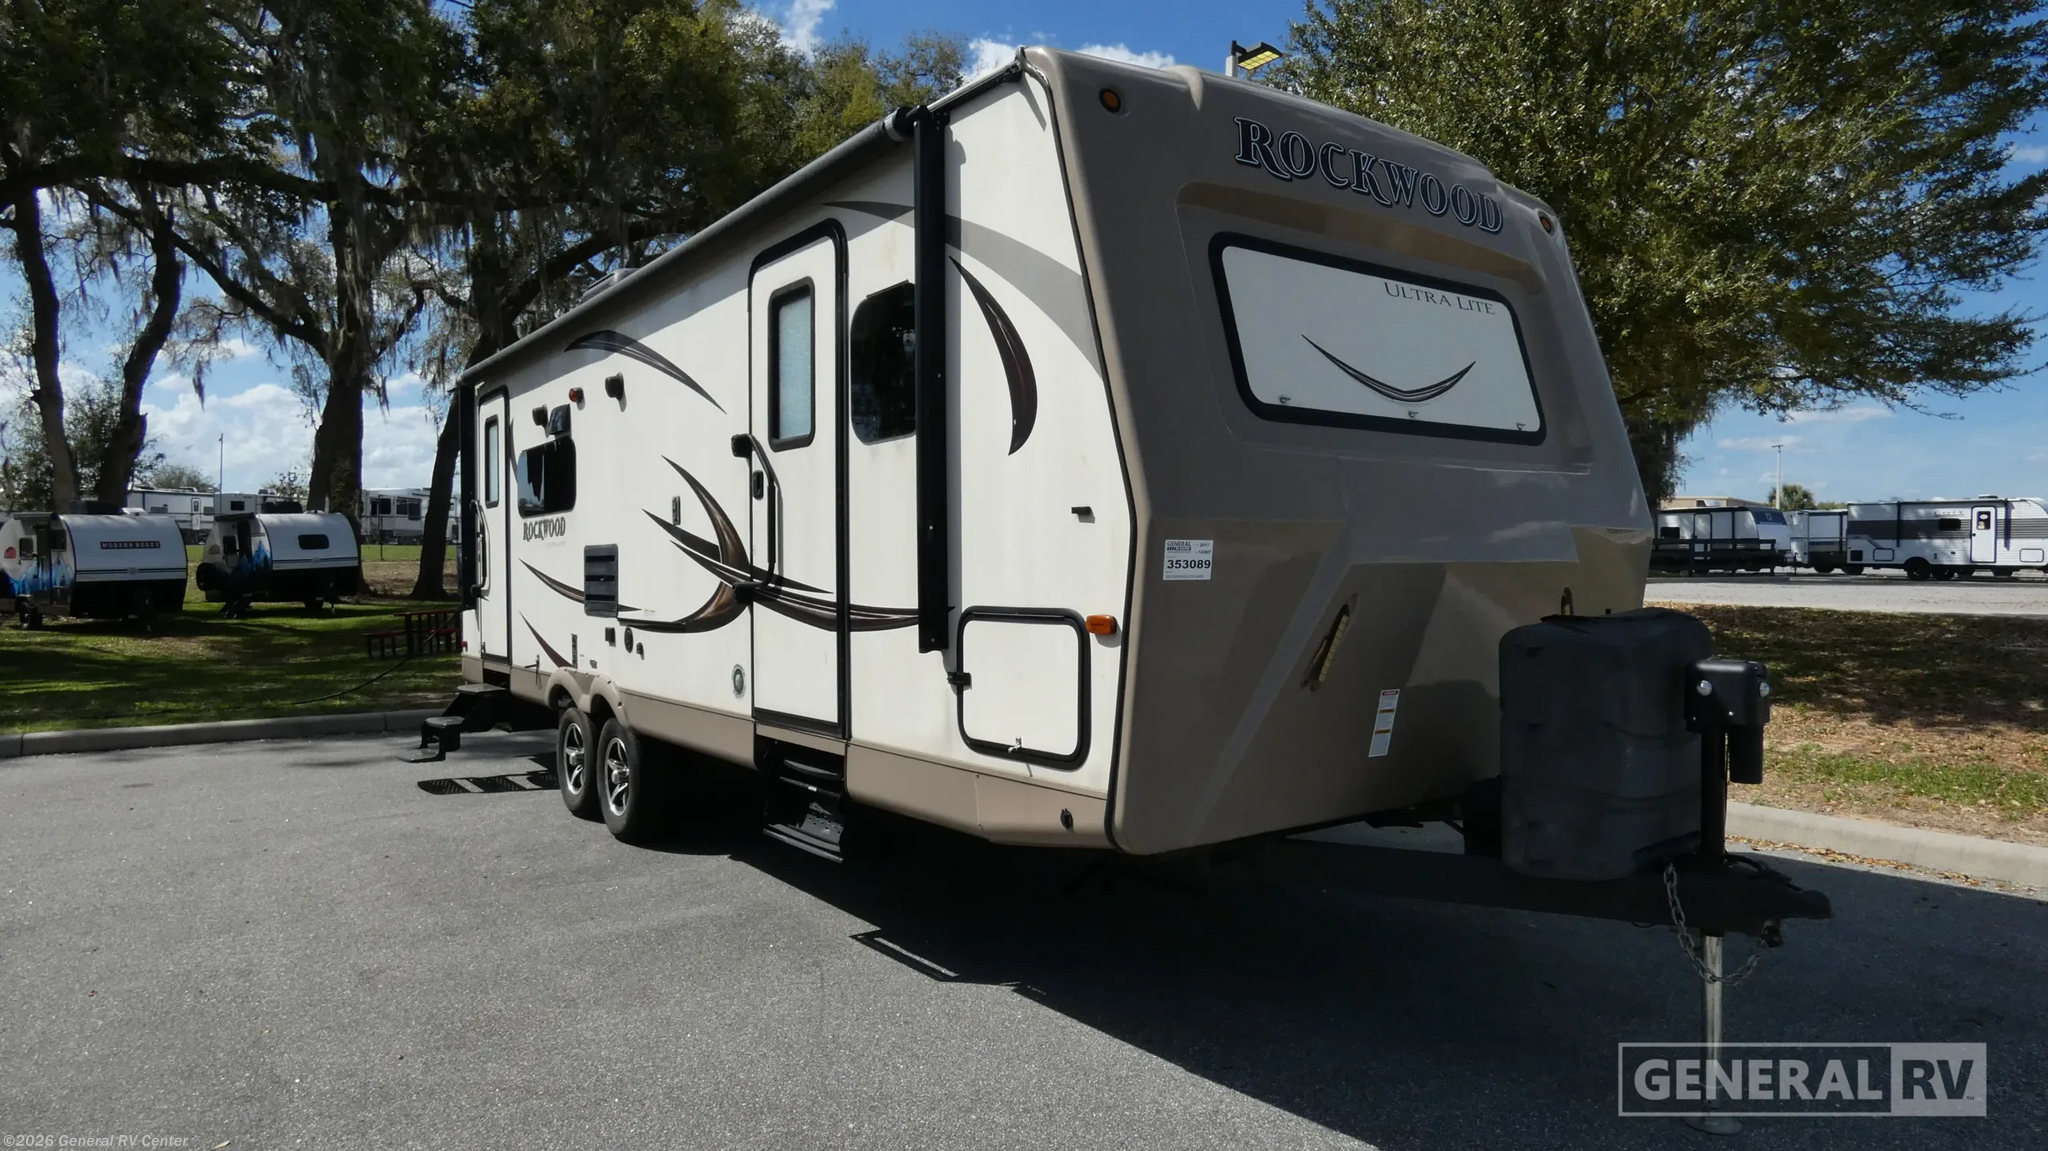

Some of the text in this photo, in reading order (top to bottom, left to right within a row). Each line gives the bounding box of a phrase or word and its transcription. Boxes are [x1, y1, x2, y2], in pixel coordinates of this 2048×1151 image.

[1234, 116, 1503, 232] ROCKWOOD
[1384, 282, 1496, 315] ULTRA LITE
[523, 516, 566, 542] ROCKWOOD
[1167, 559, 1211, 569] 353089
